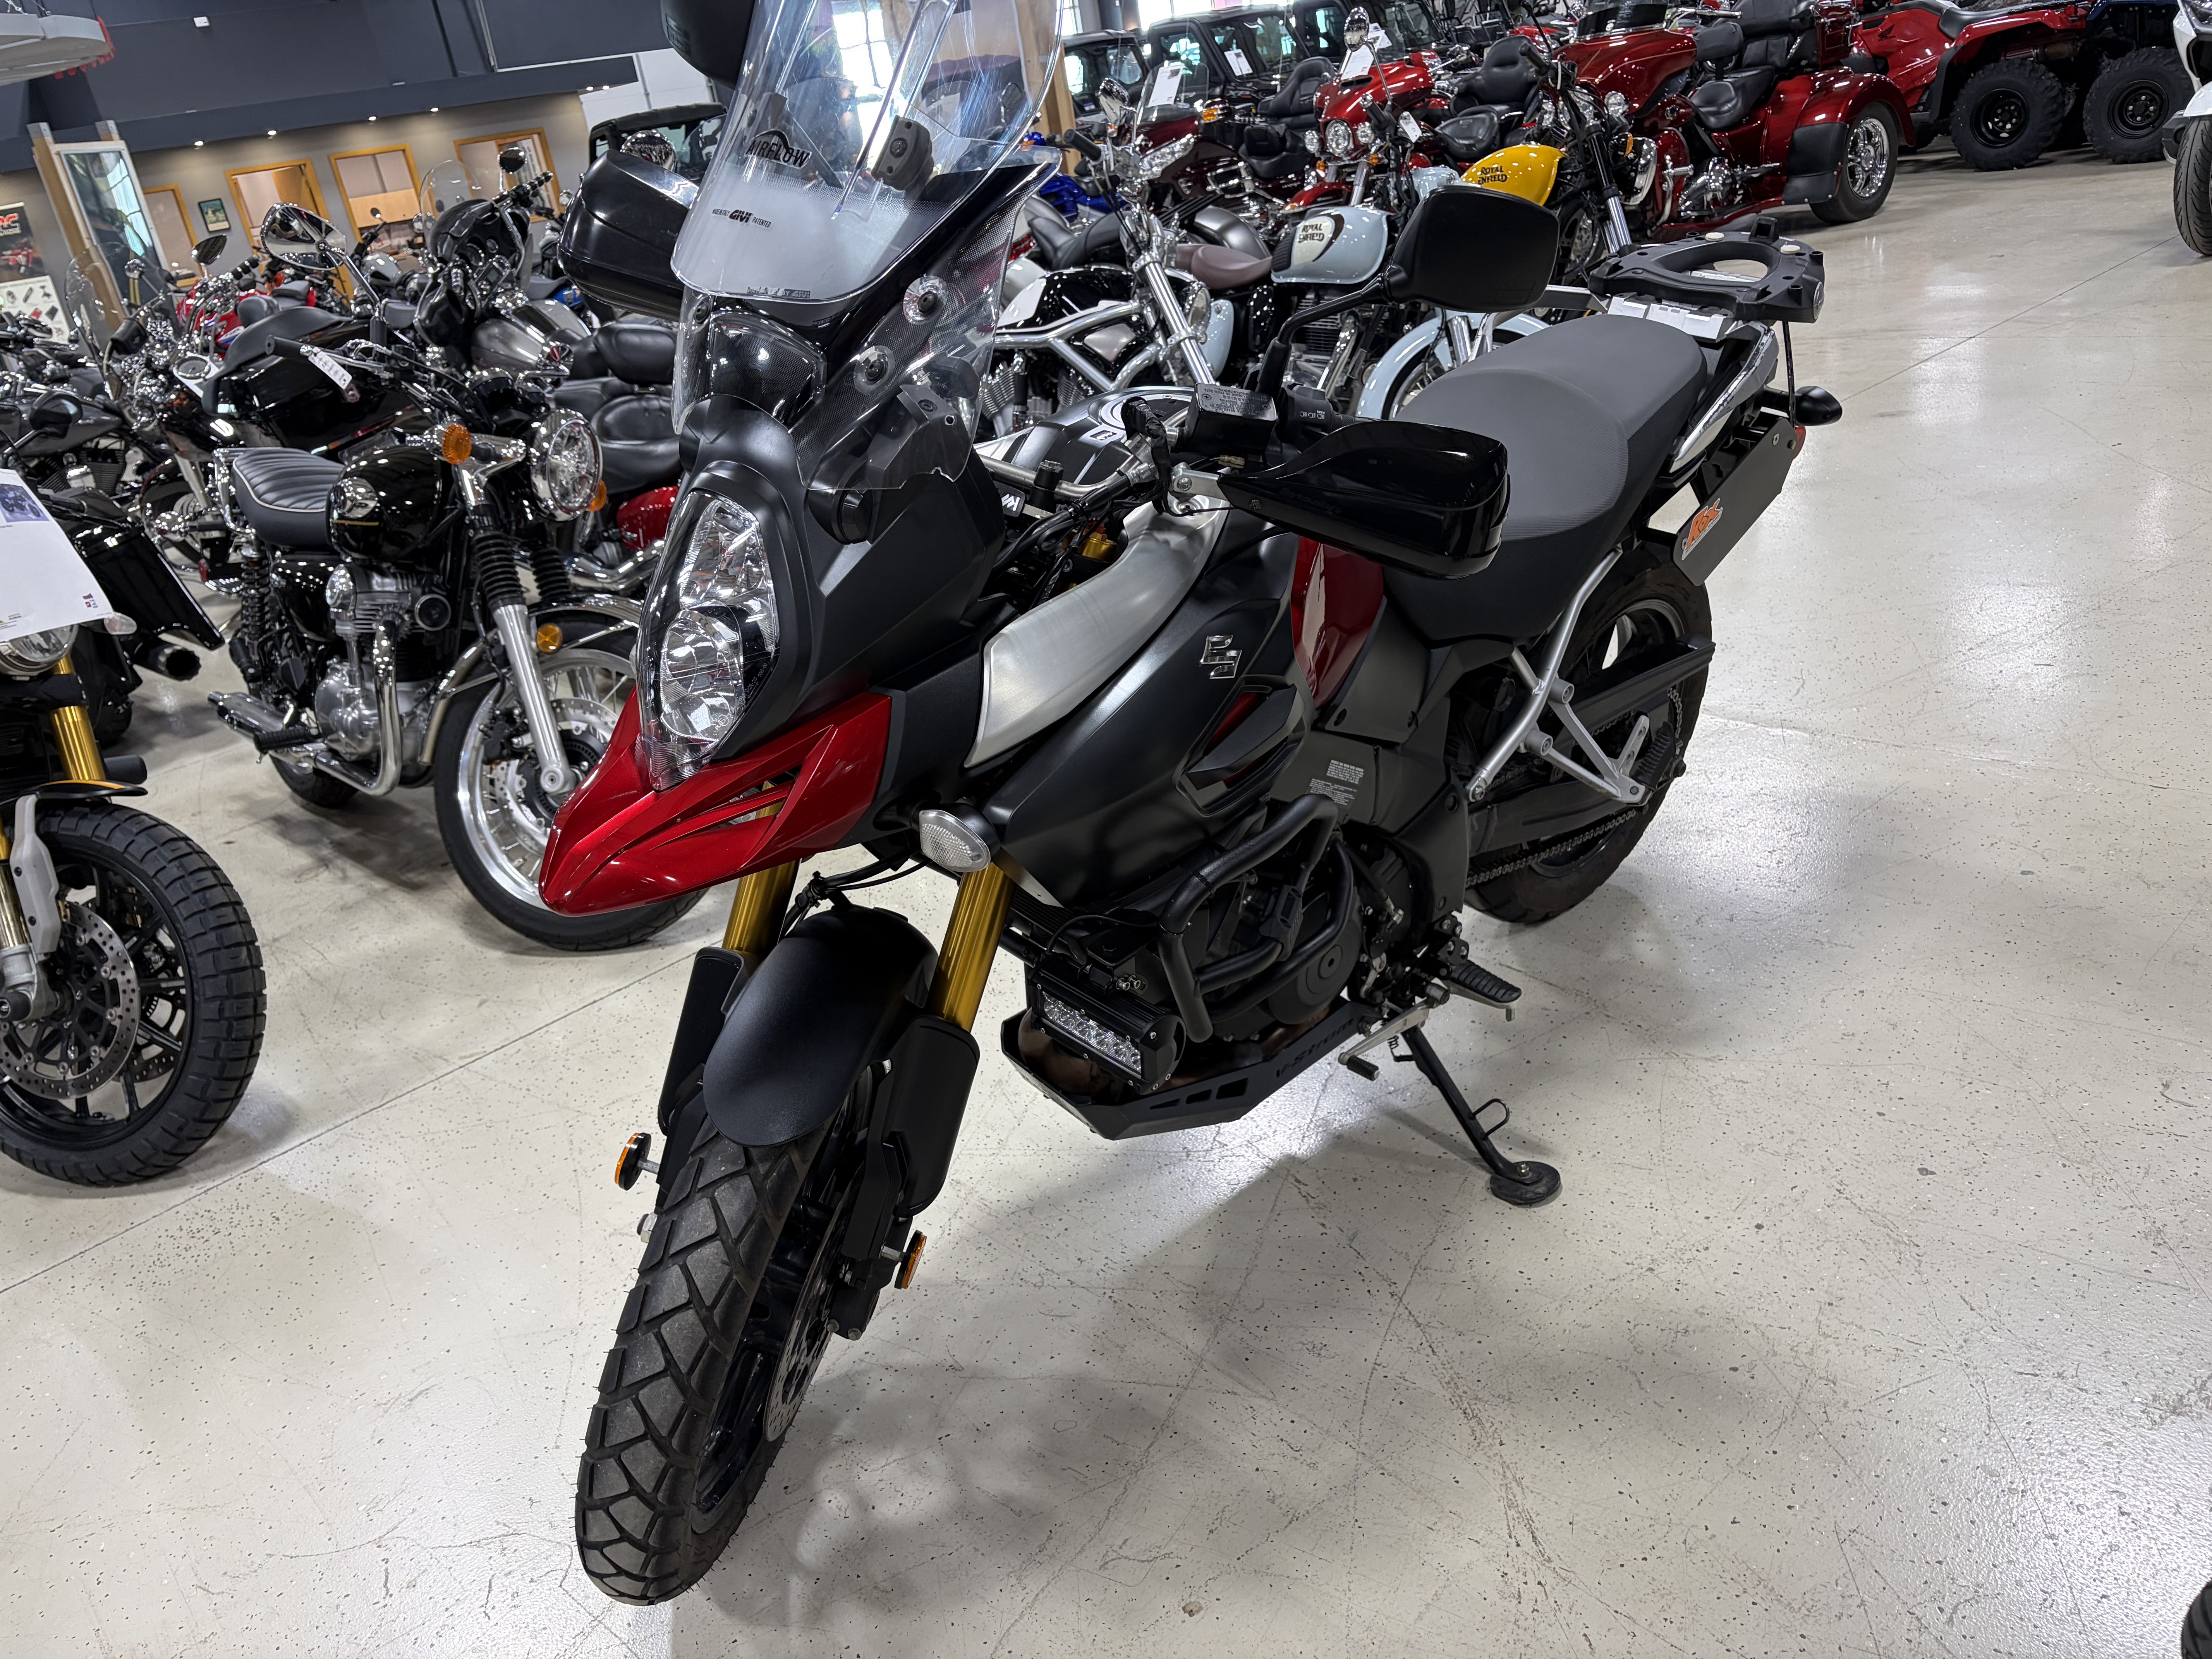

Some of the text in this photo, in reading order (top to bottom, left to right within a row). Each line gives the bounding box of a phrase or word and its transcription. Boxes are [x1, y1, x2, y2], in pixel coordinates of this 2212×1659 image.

[746, 140, 810, 167] AIRFLOW
[1481, 165, 1504, 175] ROYAL
[1478, 174, 1508, 185] ENFIELD
[729, 210, 753, 223] GIVI
[752, 217, 772, 228] PATENTED
[1301, 223, 1322, 233] ROYAL
